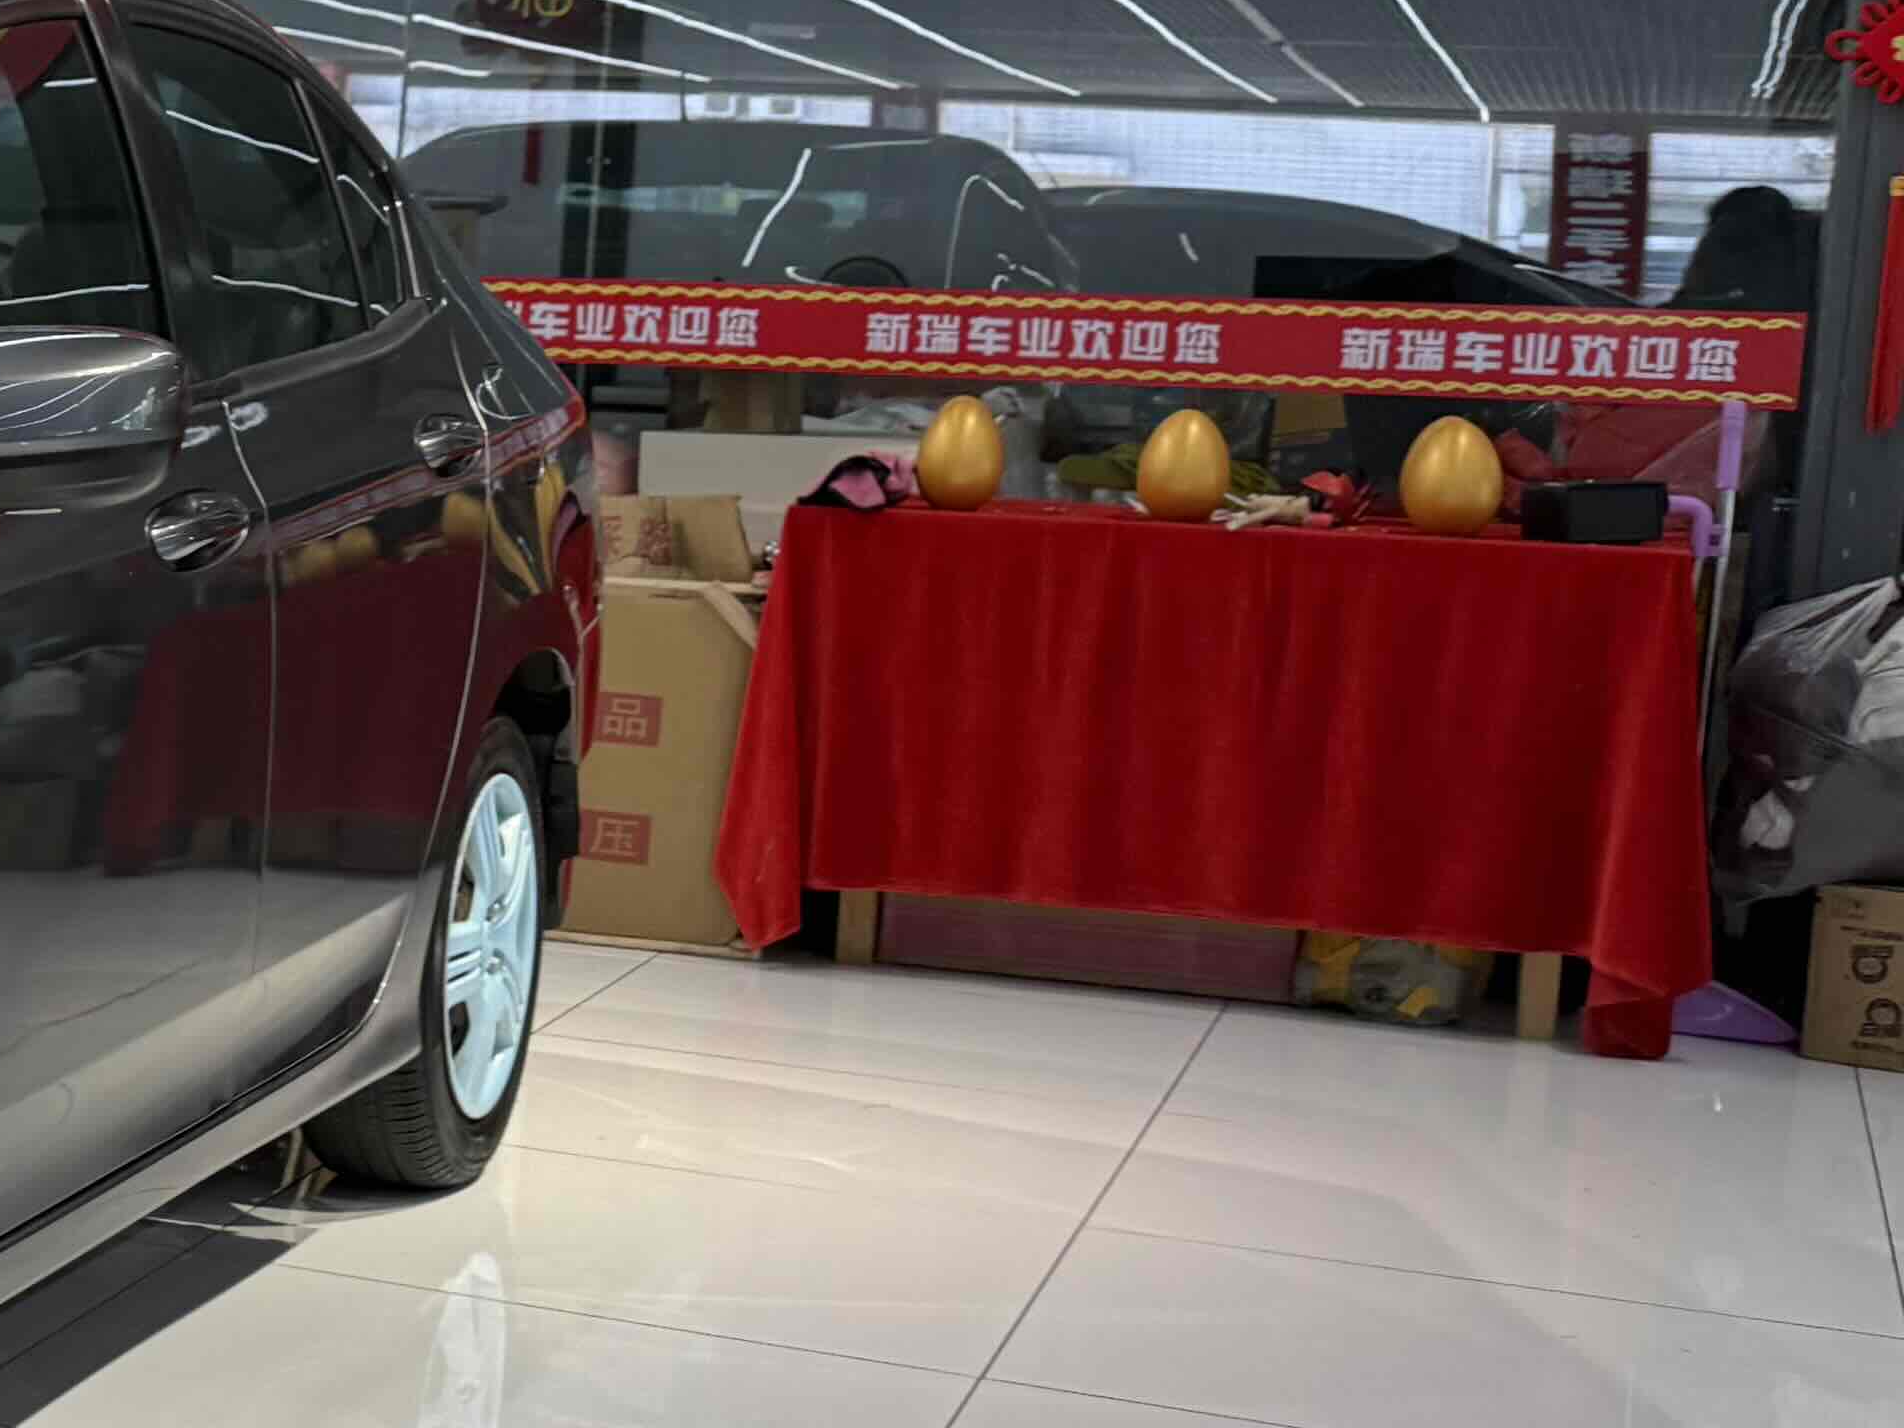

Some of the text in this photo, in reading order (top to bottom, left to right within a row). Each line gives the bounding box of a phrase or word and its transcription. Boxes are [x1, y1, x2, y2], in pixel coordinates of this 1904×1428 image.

[504, 299, 760, 348] 车业欢迎您
[866, 311, 1222, 365] 新瑞车业欢迎您
[1340, 327, 1739, 383] 新瑞车业欢迎您
[600, 697, 648, 739] 品
